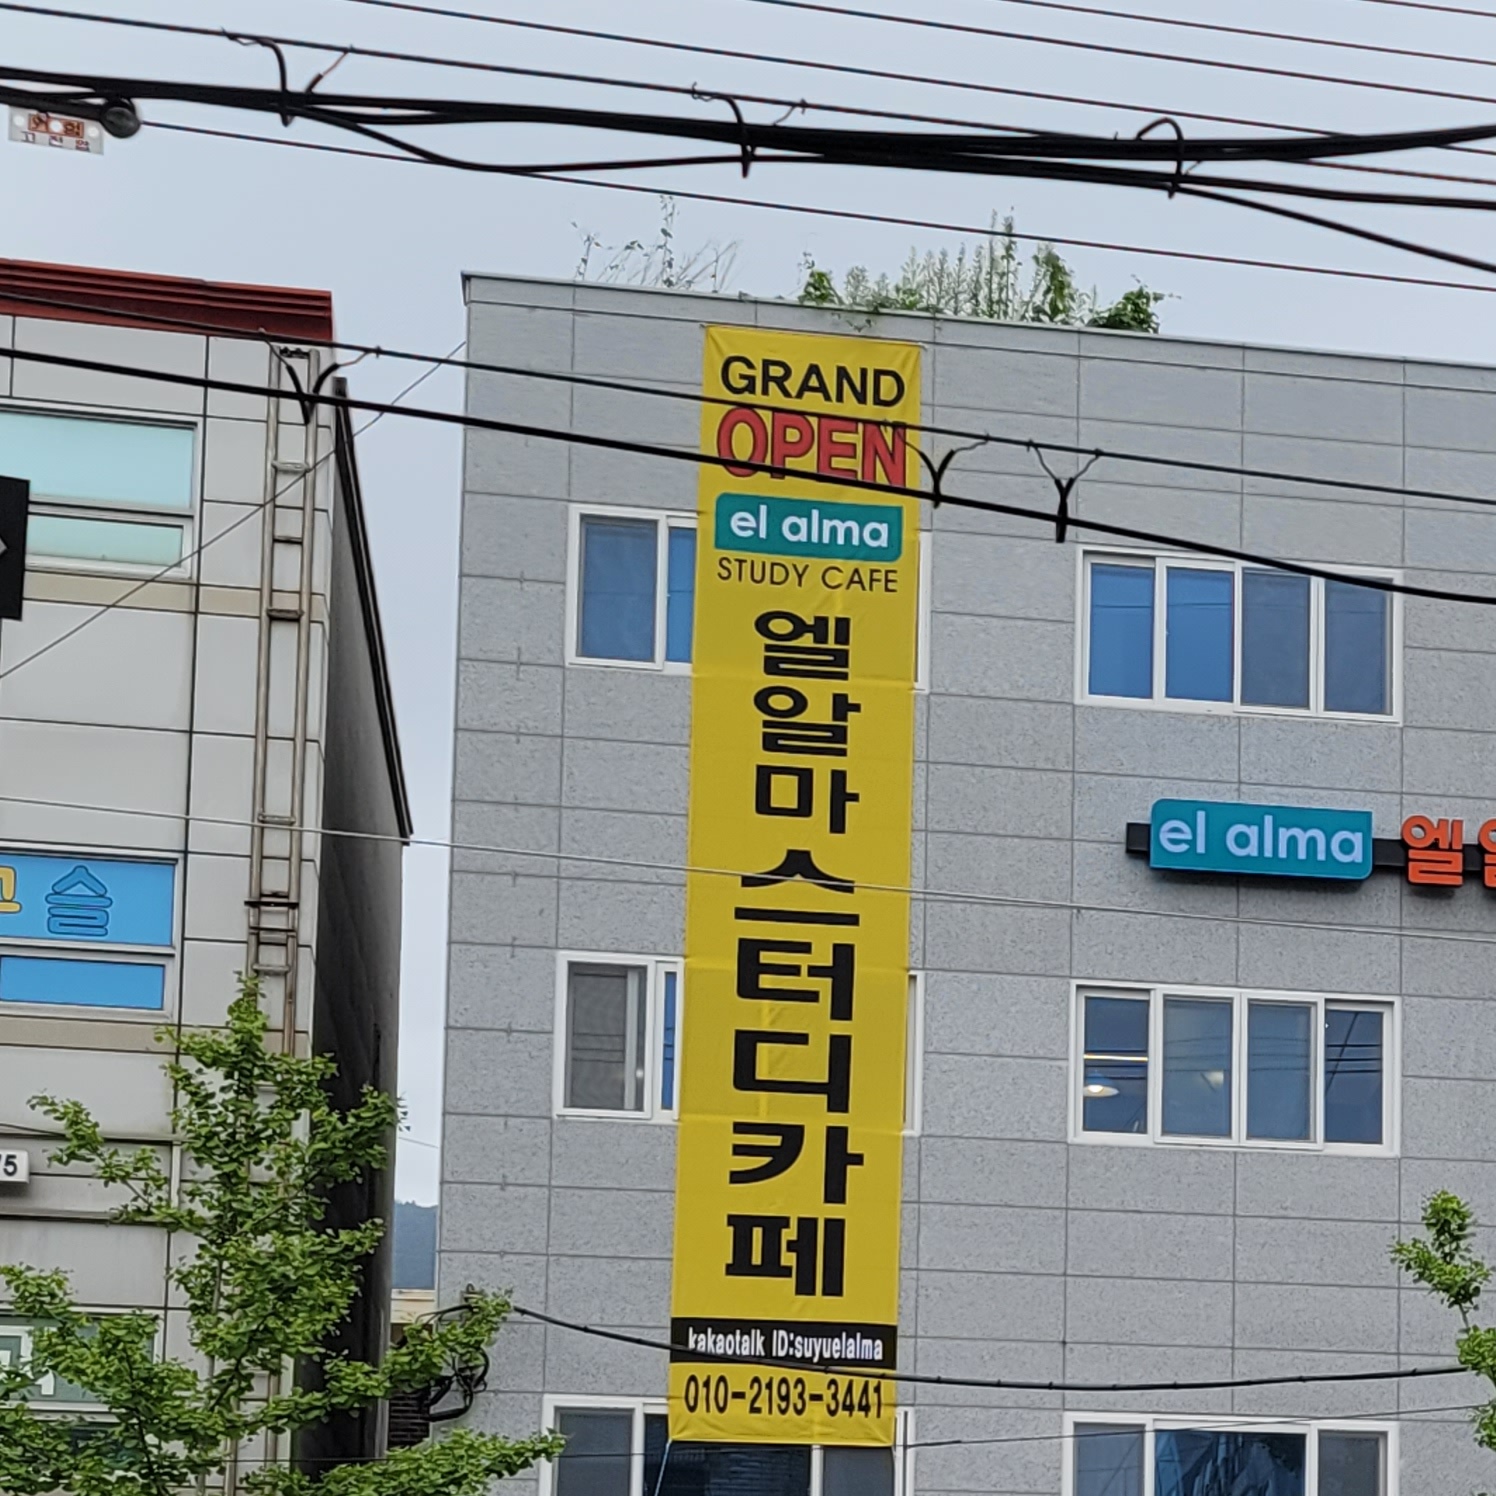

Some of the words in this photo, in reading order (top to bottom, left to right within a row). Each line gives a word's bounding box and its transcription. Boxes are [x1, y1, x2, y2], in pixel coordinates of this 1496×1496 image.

[721, 355, 905, 407] GRAND
[717, 406, 906, 488] OPEN
[730, 505, 767, 539] el
[782, 509, 889, 548] alma
[717, 557, 809, 587] STUDY
[821, 566, 898, 592] CAFE
[1159, 810, 1206, 854] el
[1226, 815, 1363, 863] alma
[688, 1326, 765, 1357] kakaotalk
[684, 1374, 883, 1419] 010-2193-3441
